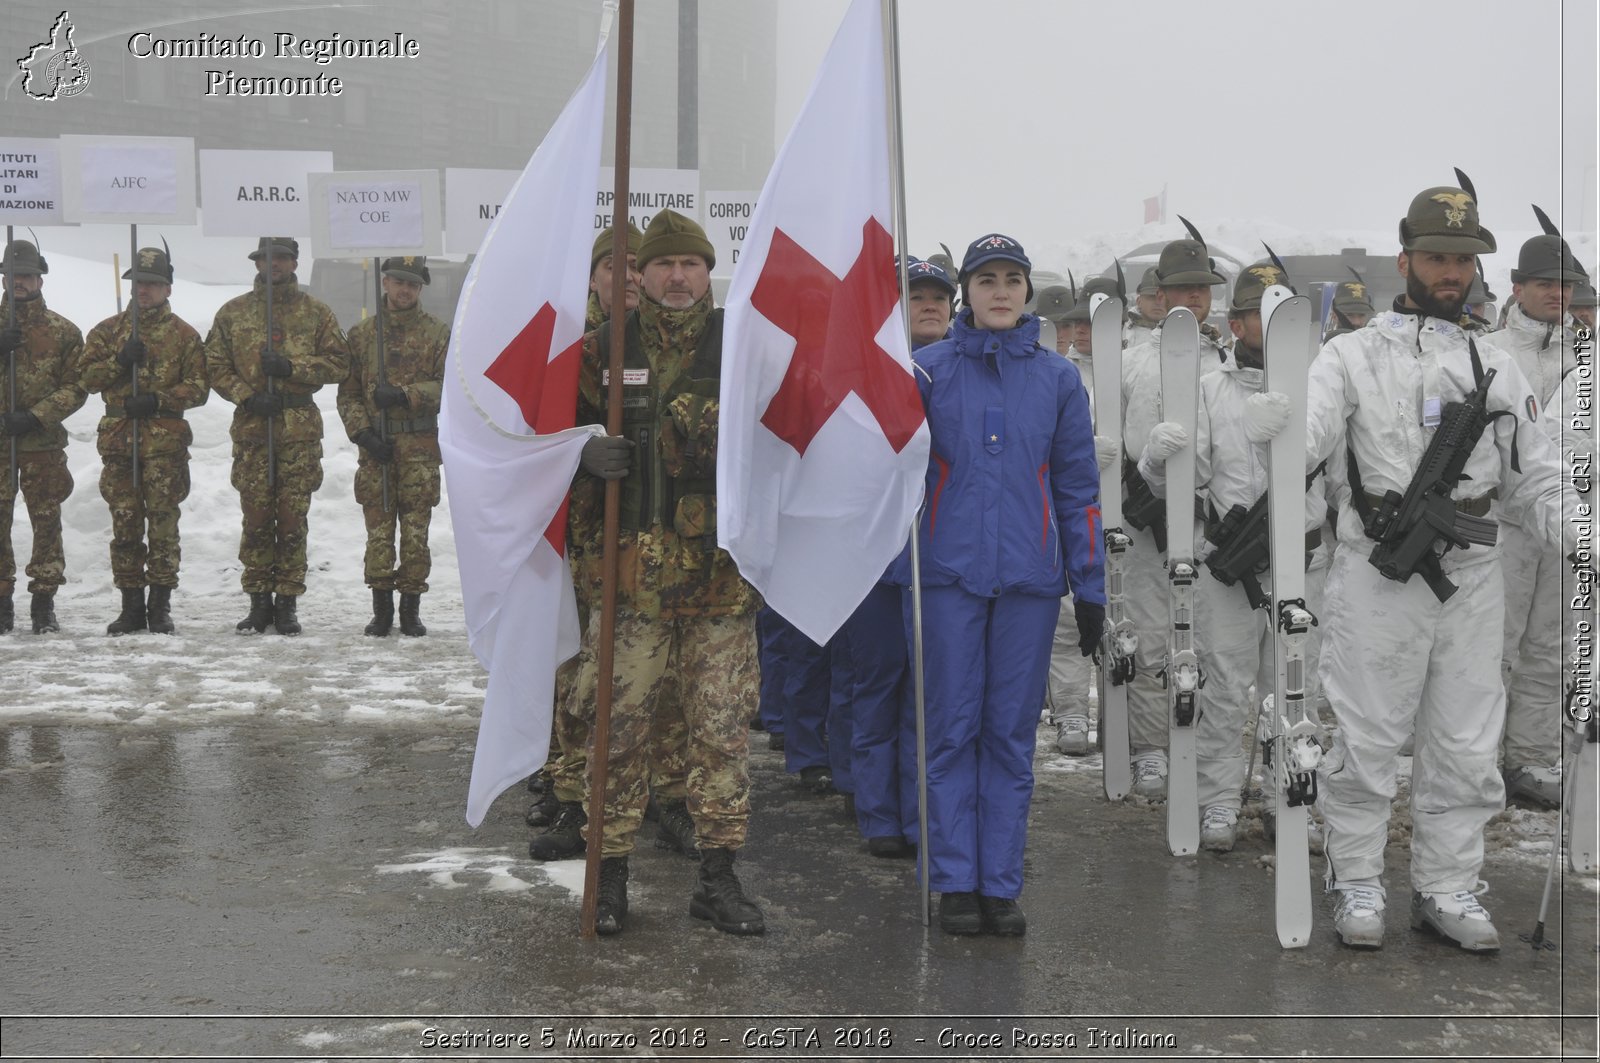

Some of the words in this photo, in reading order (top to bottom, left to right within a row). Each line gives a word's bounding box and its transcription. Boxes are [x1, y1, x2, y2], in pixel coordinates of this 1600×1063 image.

[0, 153, 36, 163] ITUTI
[4, 184, 17, 194] DI
[111, 175, 147, 190] AJFC
[237, 186, 300, 203] A.R.R.C.
[336, 191, 379, 204] NATO
[384, 190, 411, 203] MW
[629, 192, 694, 209] MILITARE
[360, 210, 391, 224] COE
[710, 203, 750, 218] CORPO
